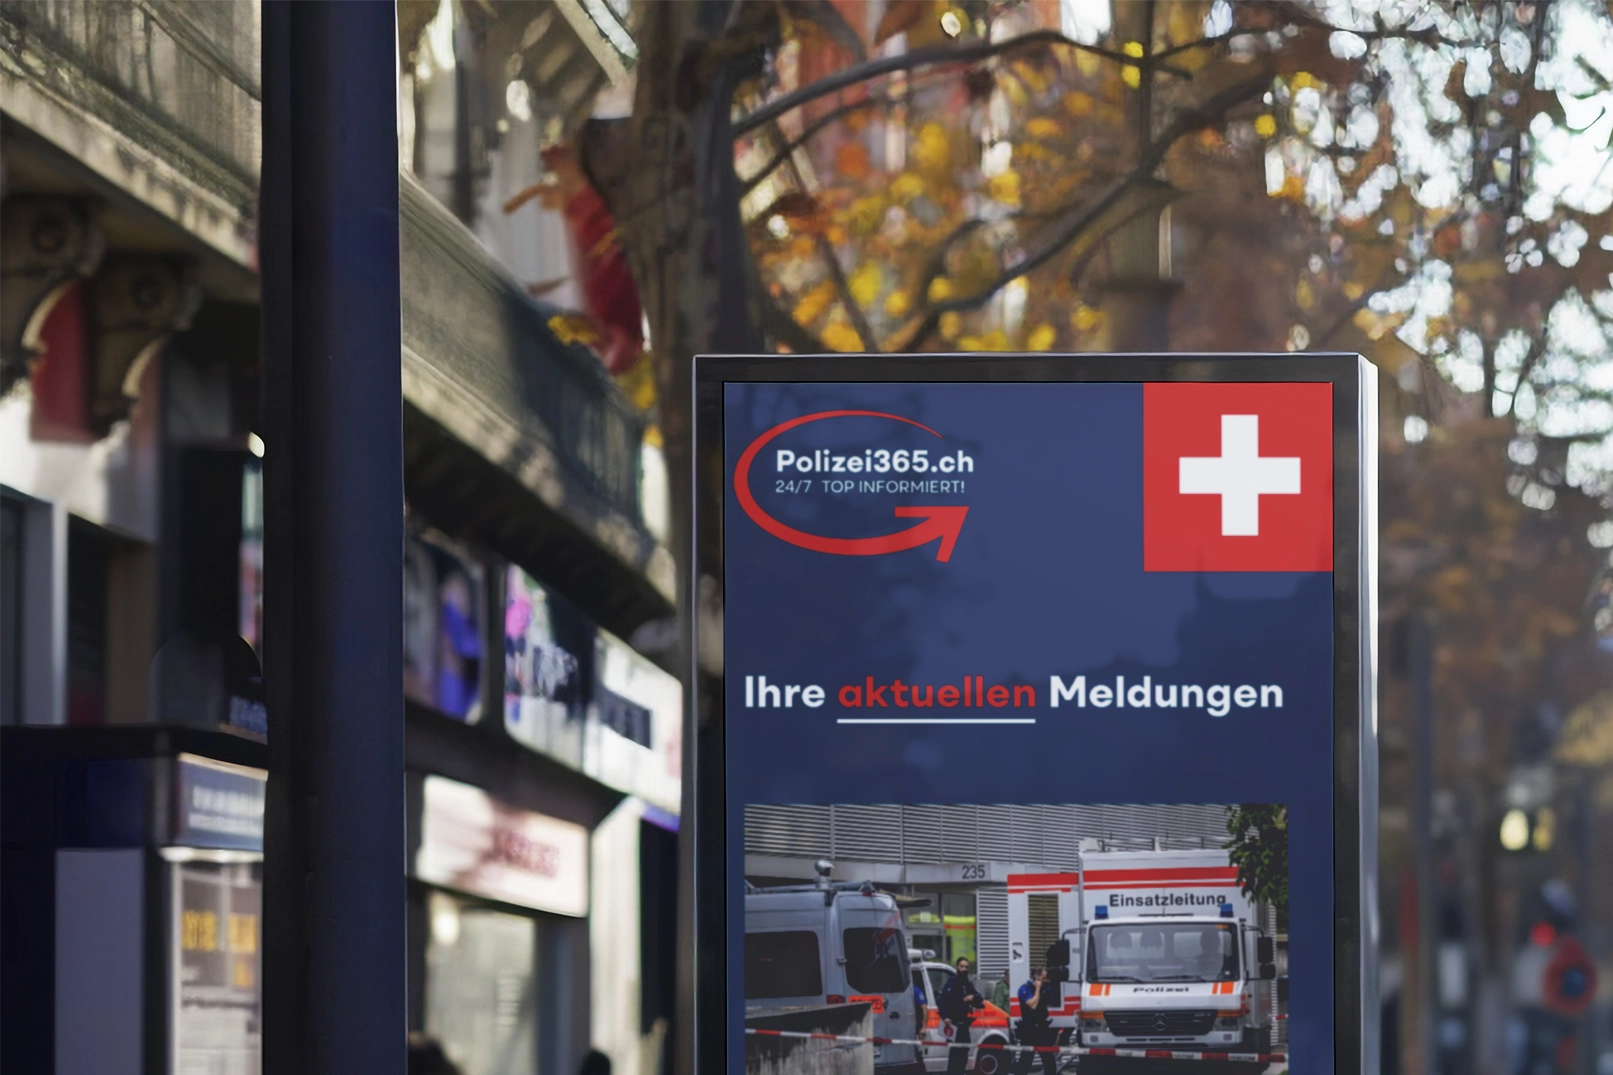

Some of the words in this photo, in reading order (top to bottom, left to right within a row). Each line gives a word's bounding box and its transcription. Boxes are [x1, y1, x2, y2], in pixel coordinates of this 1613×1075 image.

[776, 448, 974, 474] Polizei365.ch
[775, 479, 812, 493] 24/7
[822, 479, 856, 493] TOP
[859, 479, 966, 493] INFORMIERT!
[745, 675, 826, 708] Ihre
[837, 675, 1036, 708] aktuellen
[1049, 675, 1284, 717] Meldungen
[961, 863, 986, 880] 235
[1108, 892, 1227, 908] Einsatzleitung
